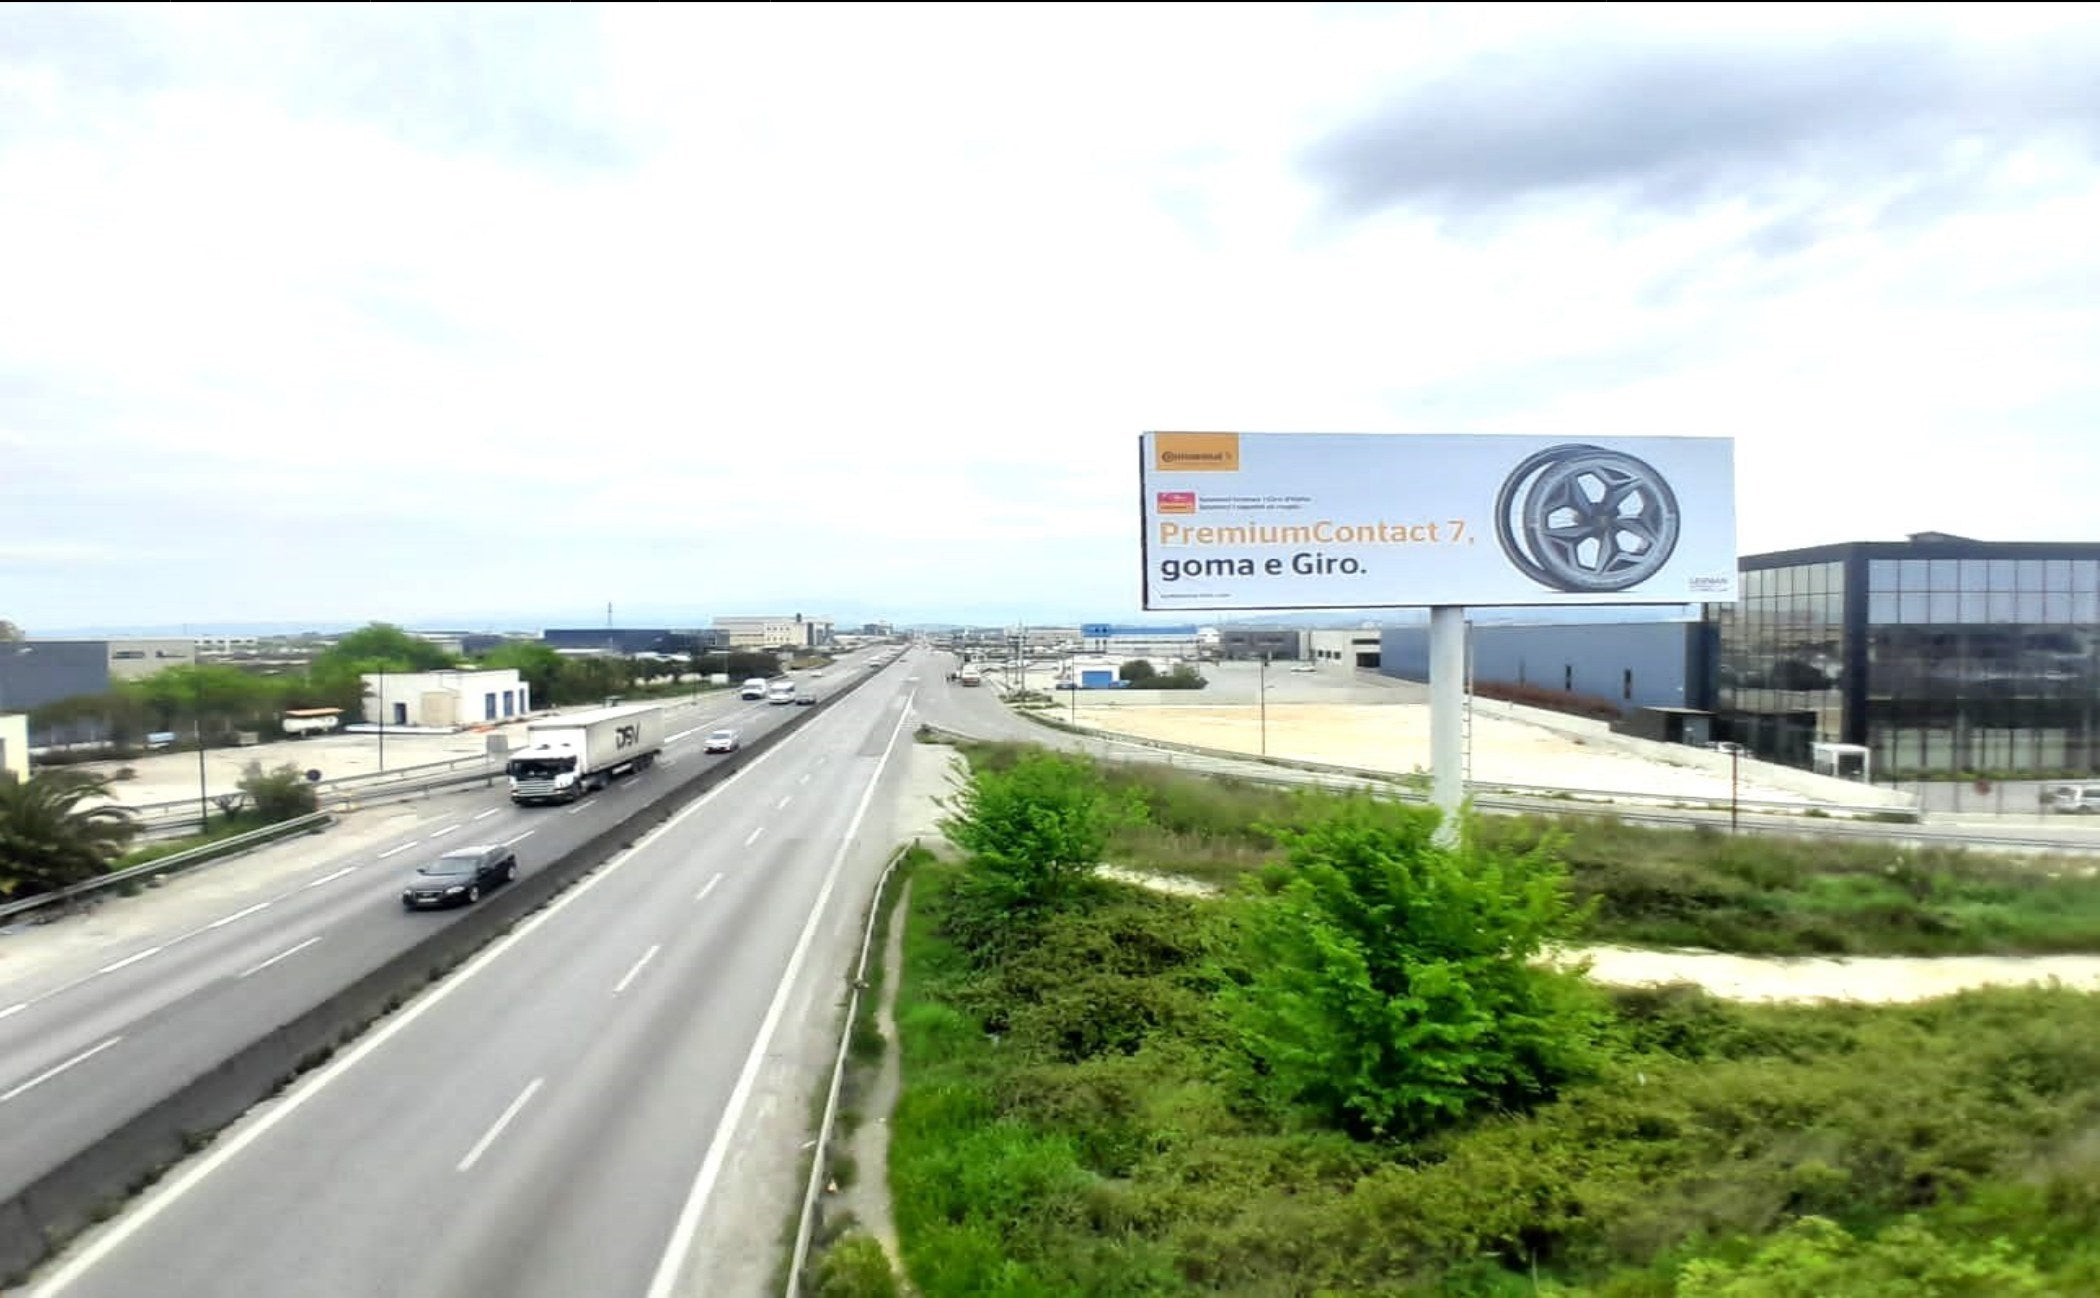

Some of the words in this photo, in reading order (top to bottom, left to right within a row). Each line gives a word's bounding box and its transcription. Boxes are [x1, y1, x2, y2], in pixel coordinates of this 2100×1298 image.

[1159, 519, 1439, 546] PremiumContact
[1447, 520, 1475, 545] 7,
[1160, 555, 1256, 582] goma
[1263, 557, 1284, 576] e
[1291, 552, 1368, 576] Giro.
[615, 721, 641, 749] DSV
